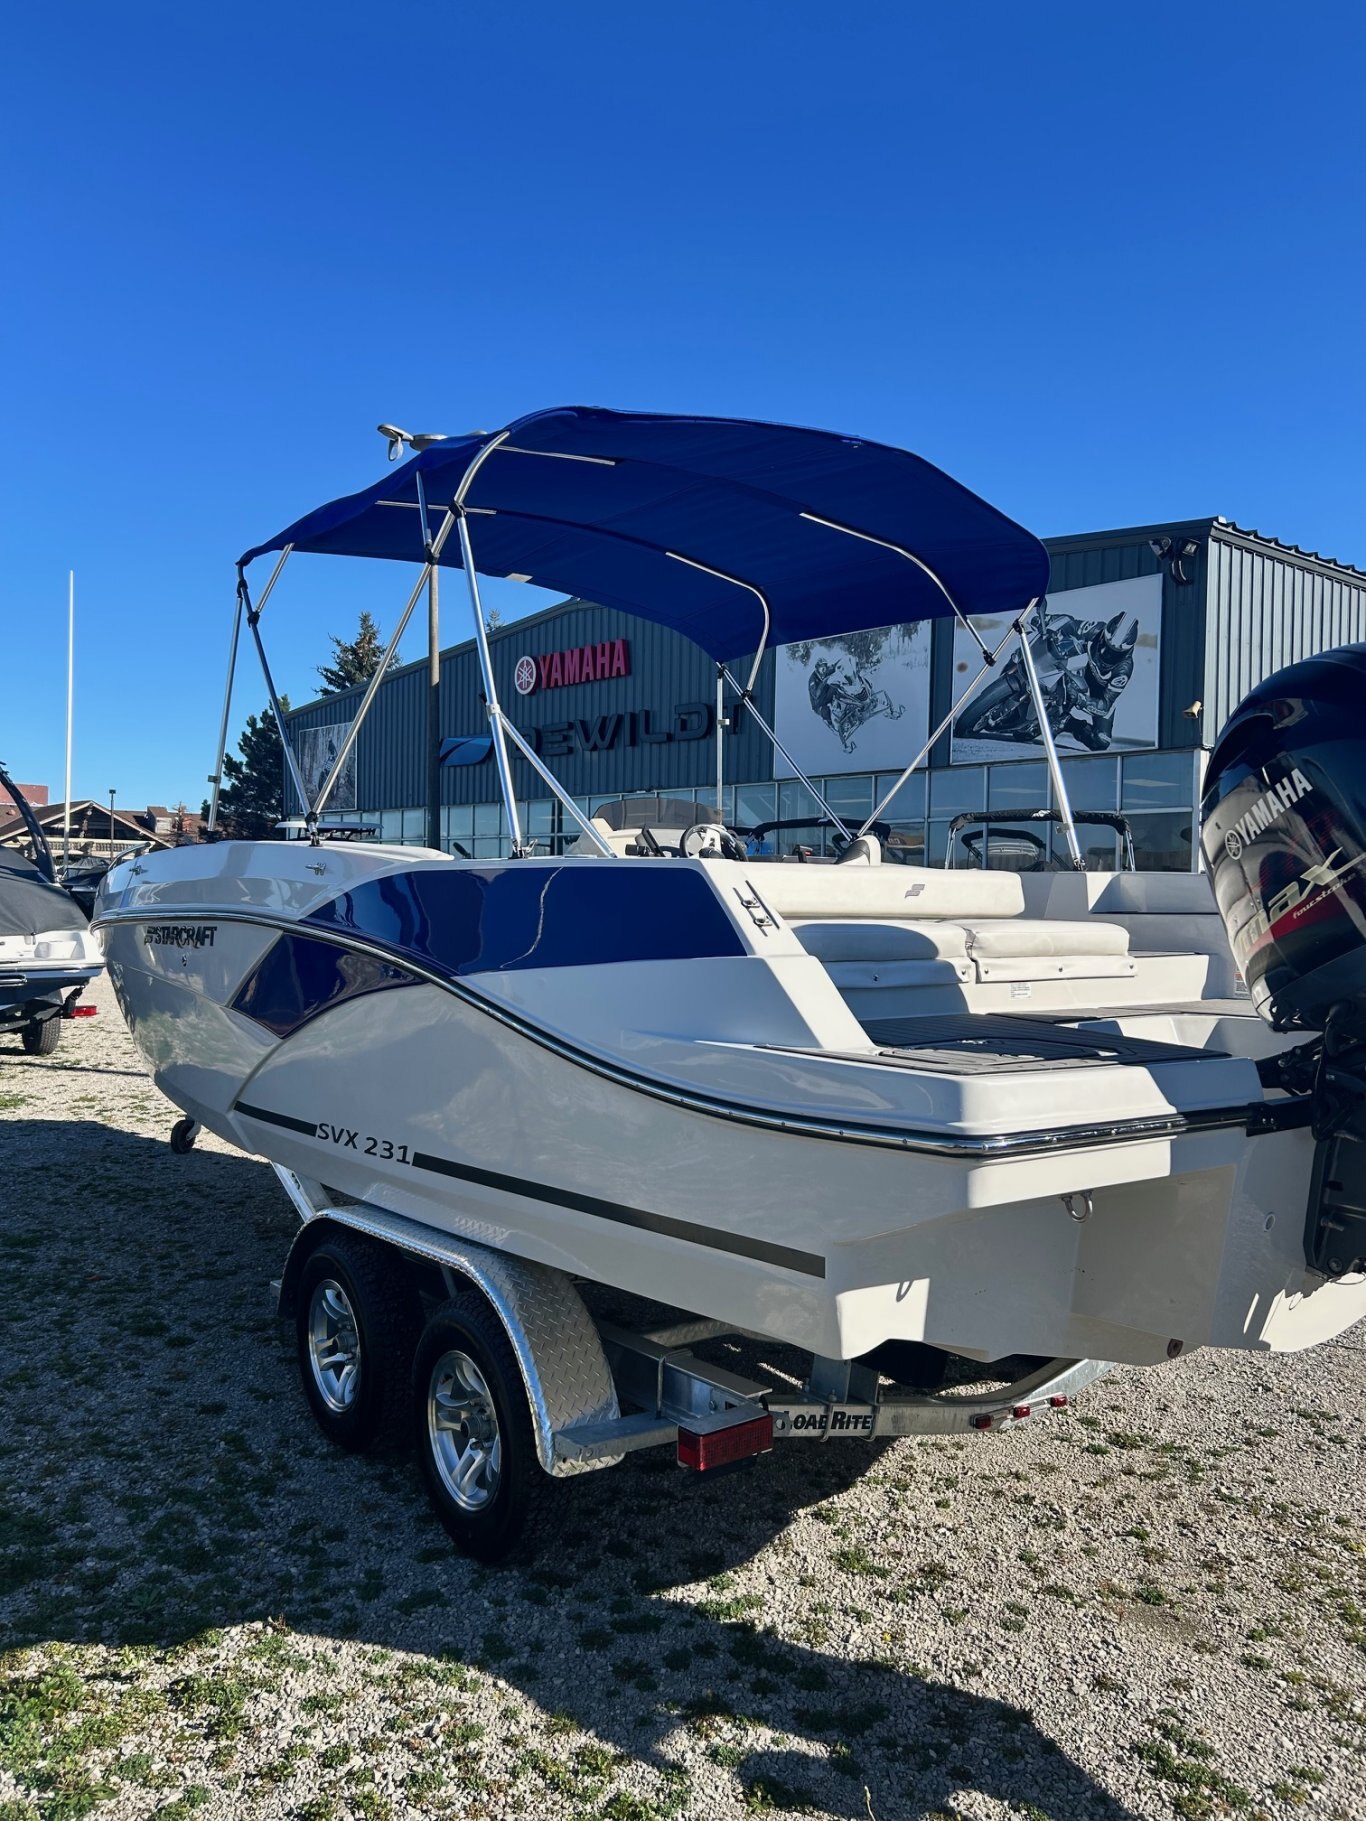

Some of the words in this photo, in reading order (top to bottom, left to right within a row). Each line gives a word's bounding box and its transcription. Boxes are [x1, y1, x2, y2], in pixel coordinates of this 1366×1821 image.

[538, 639, 629, 689] YAMAHA
[1236, 768, 1313, 845] YAMAHA
[154, 925, 218, 949] STARCRAFT
[317, 1122, 359, 1150] SVX
[363, 1136, 411, 1165] 231
